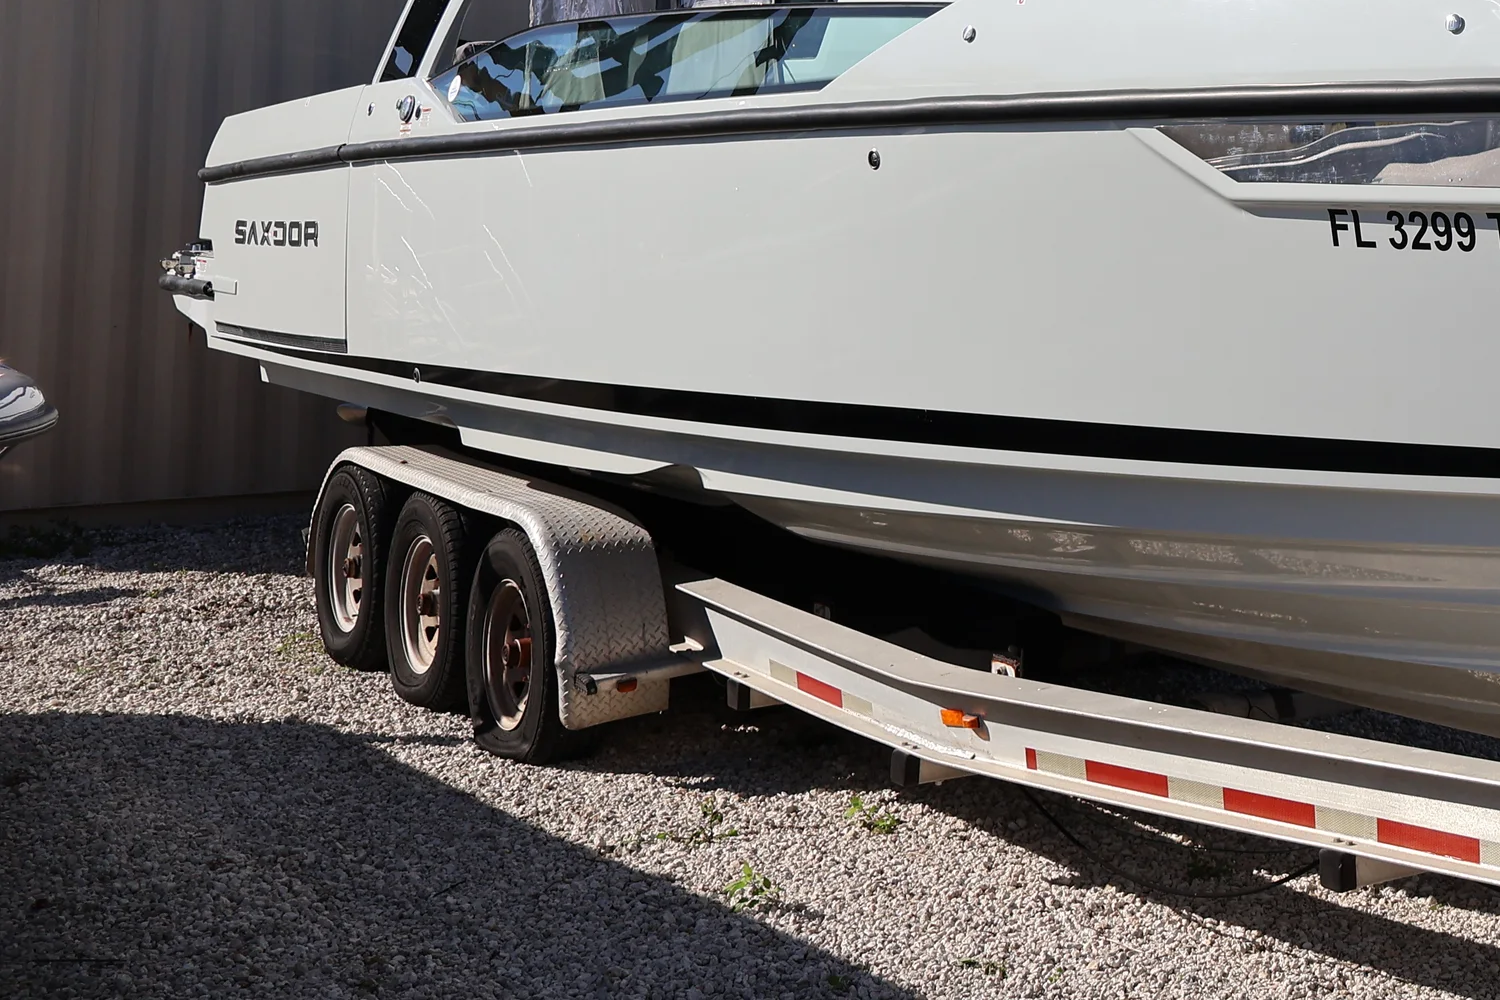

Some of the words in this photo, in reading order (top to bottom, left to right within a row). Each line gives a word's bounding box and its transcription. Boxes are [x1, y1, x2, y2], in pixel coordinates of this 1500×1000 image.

[234, 219, 319, 247] SAXDOR
[1327, 208, 1377, 249] FL
[1386, 209, 1476, 253] 3299
